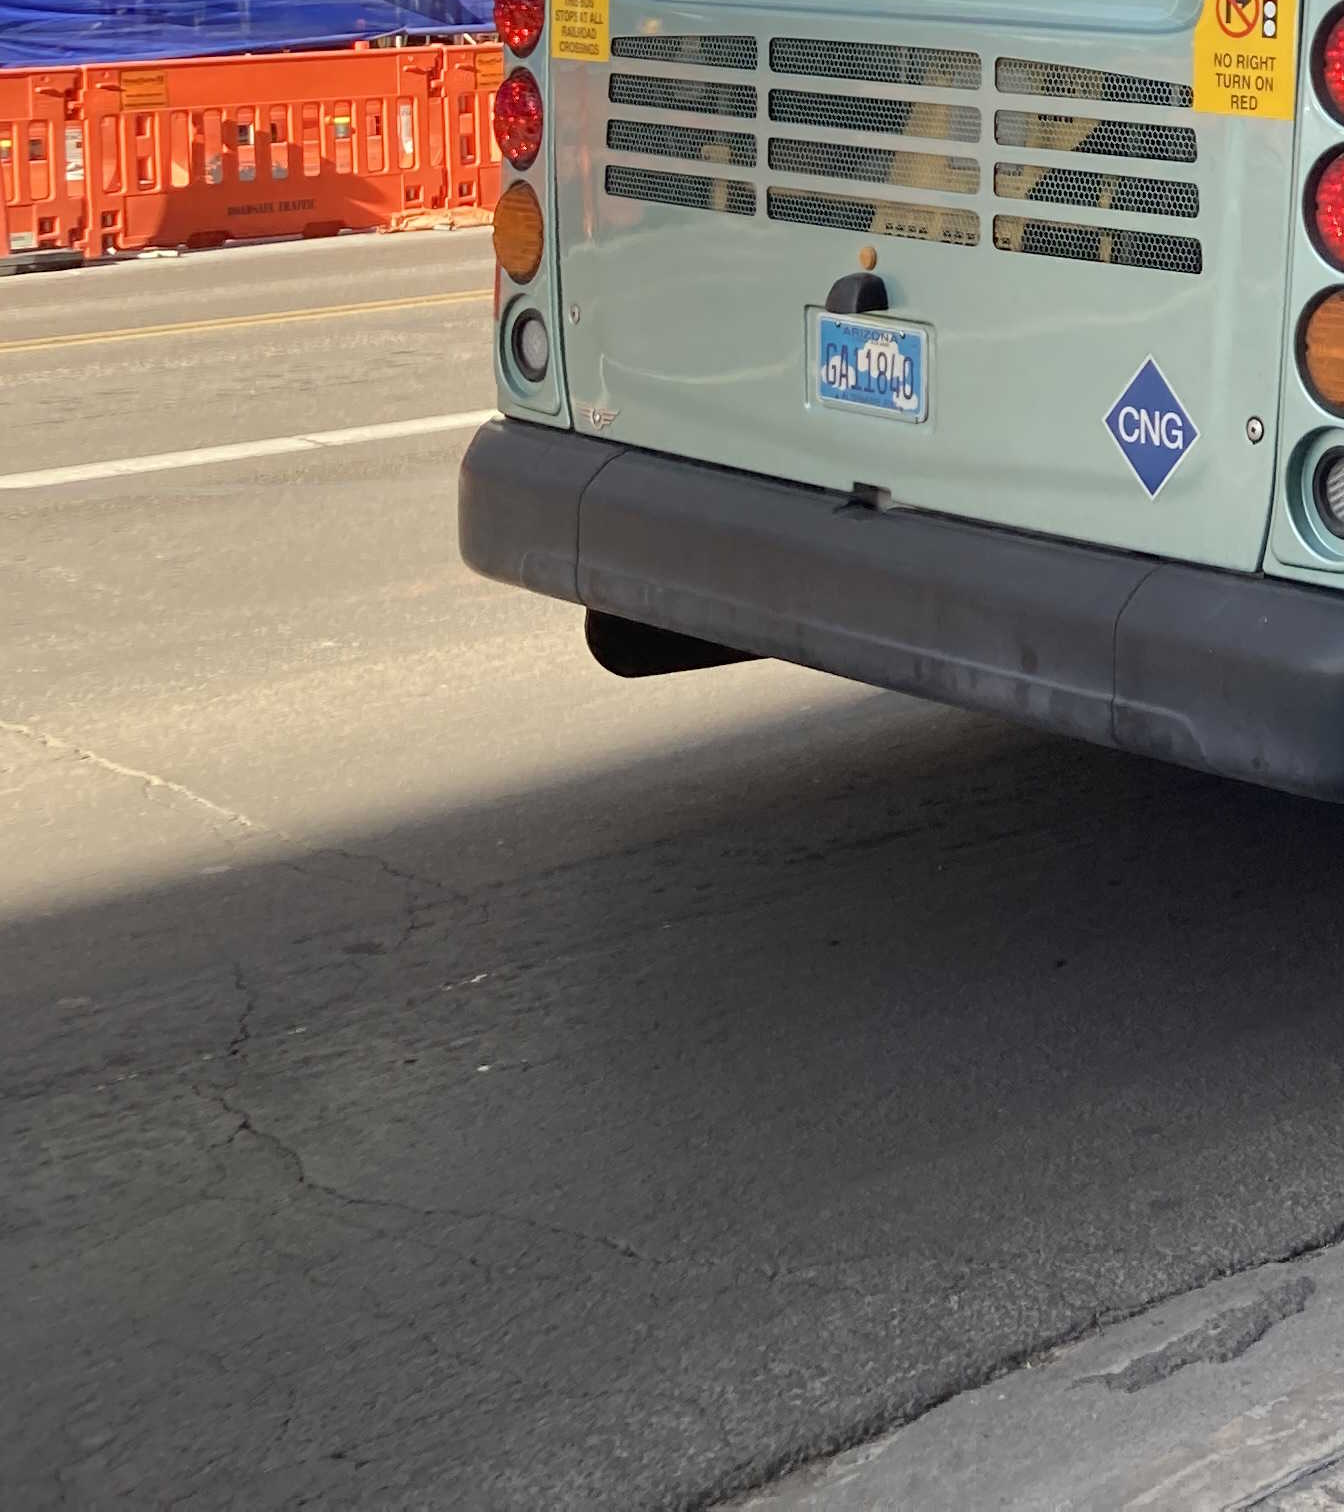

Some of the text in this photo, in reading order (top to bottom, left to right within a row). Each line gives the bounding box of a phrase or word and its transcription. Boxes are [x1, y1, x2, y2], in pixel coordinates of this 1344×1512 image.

[555, 9, 578, 23] STOPS
[590, 12, 604, 25] ALL
[561, 25, 598, 40] RAILROAD
[559, 41, 600, 56] CROSSINGS
[1213, 52, 1277, 71] NO RIGHT
[1215, 72, 1275, 93] TURN ON
[1230, 94, 1259, 112] RED
[843, 327, 898, 344] ARIZONA
[825, 342, 914, 400] GA11840
[1118, 406, 1184, 450] CNG
